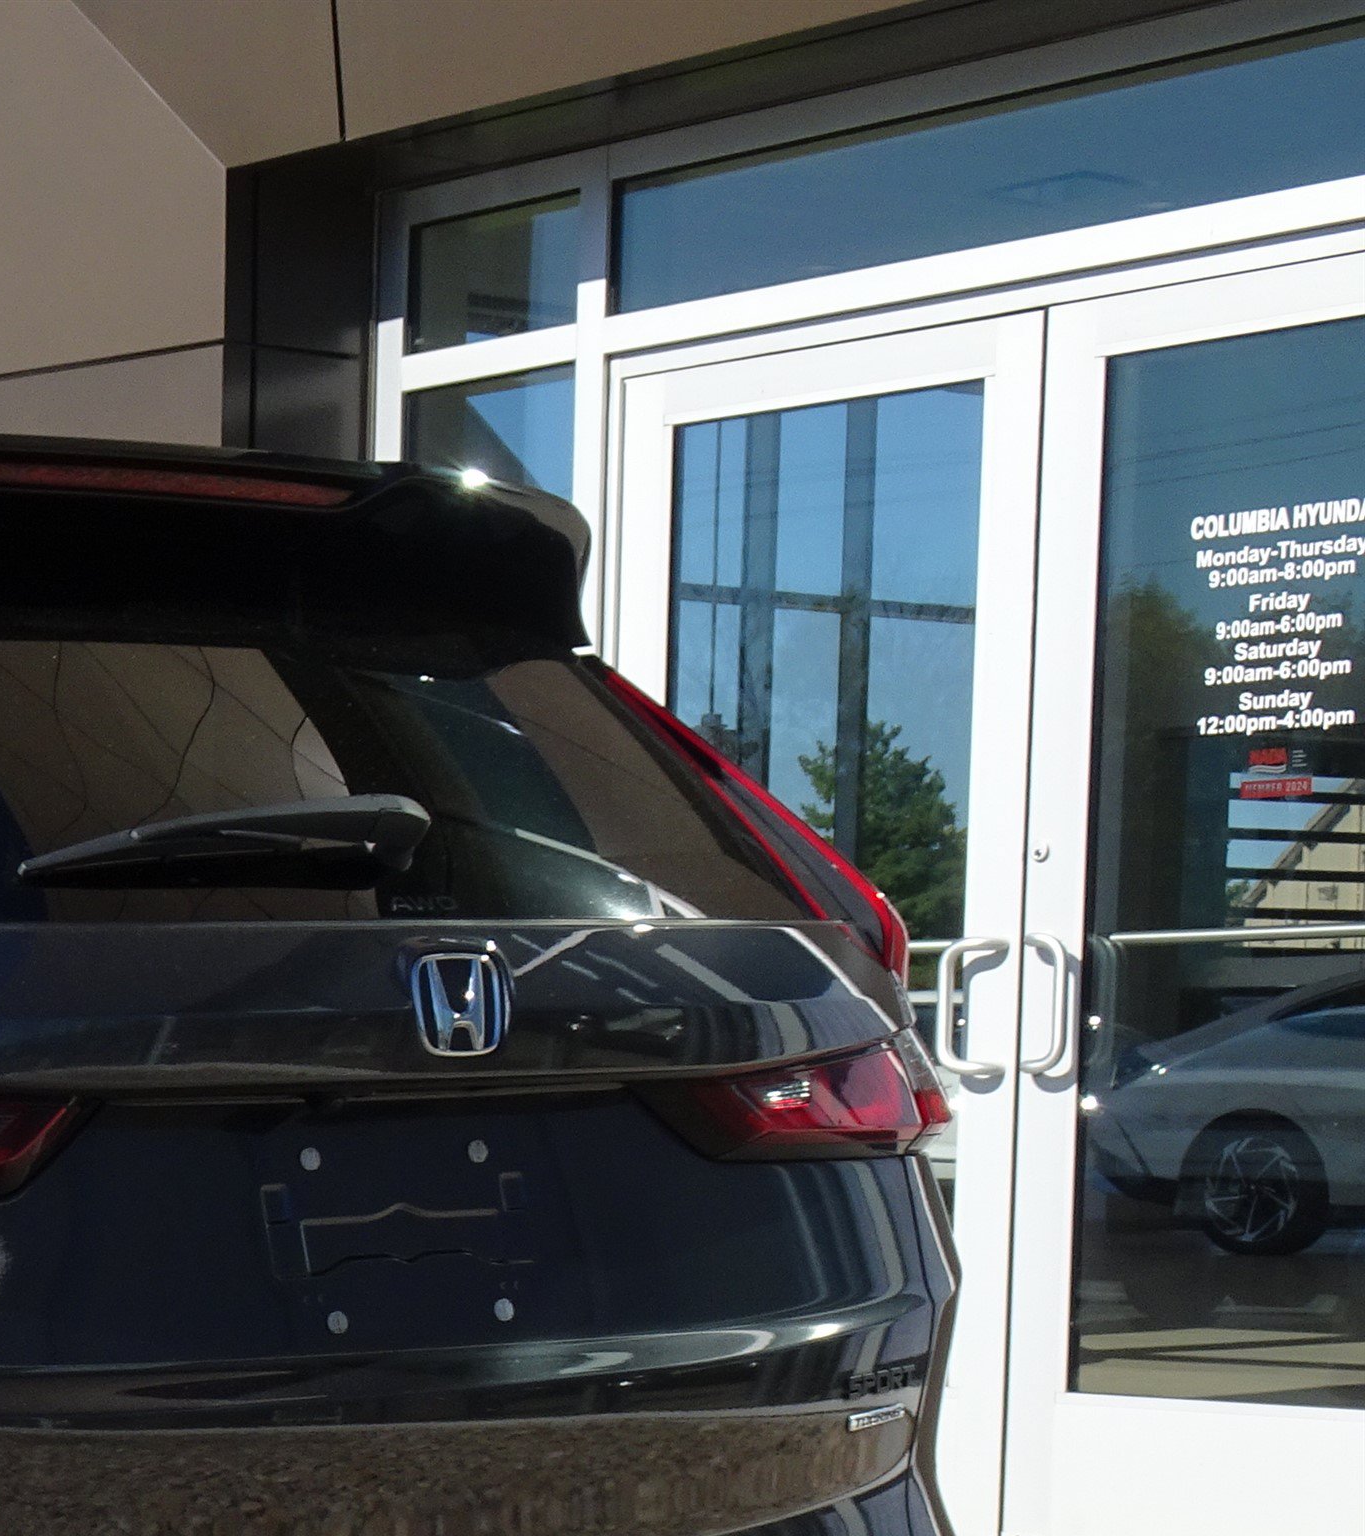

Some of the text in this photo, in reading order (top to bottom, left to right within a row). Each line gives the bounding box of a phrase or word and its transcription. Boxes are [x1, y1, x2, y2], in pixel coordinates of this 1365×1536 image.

[1190, 506, 1291, 541] COLUMBIA
[1195, 535, 1365, 569] Monday-Thursday
[1208, 558, 1357, 589] 9:00am-8:00pm
[1248, 590, 1311, 613] Friday
[1215, 611, 1344, 641] 9:00am-6:00pm
[1233, 637, 1322, 662] Saturday
[1204, 658, 1352, 686] 9:00am-6:00pm
[1238, 689, 1313, 711] Sunday
[1196, 707, 1356, 736] 12:00pm-4:00pm
[849, 1364, 916, 1399] SPORT
